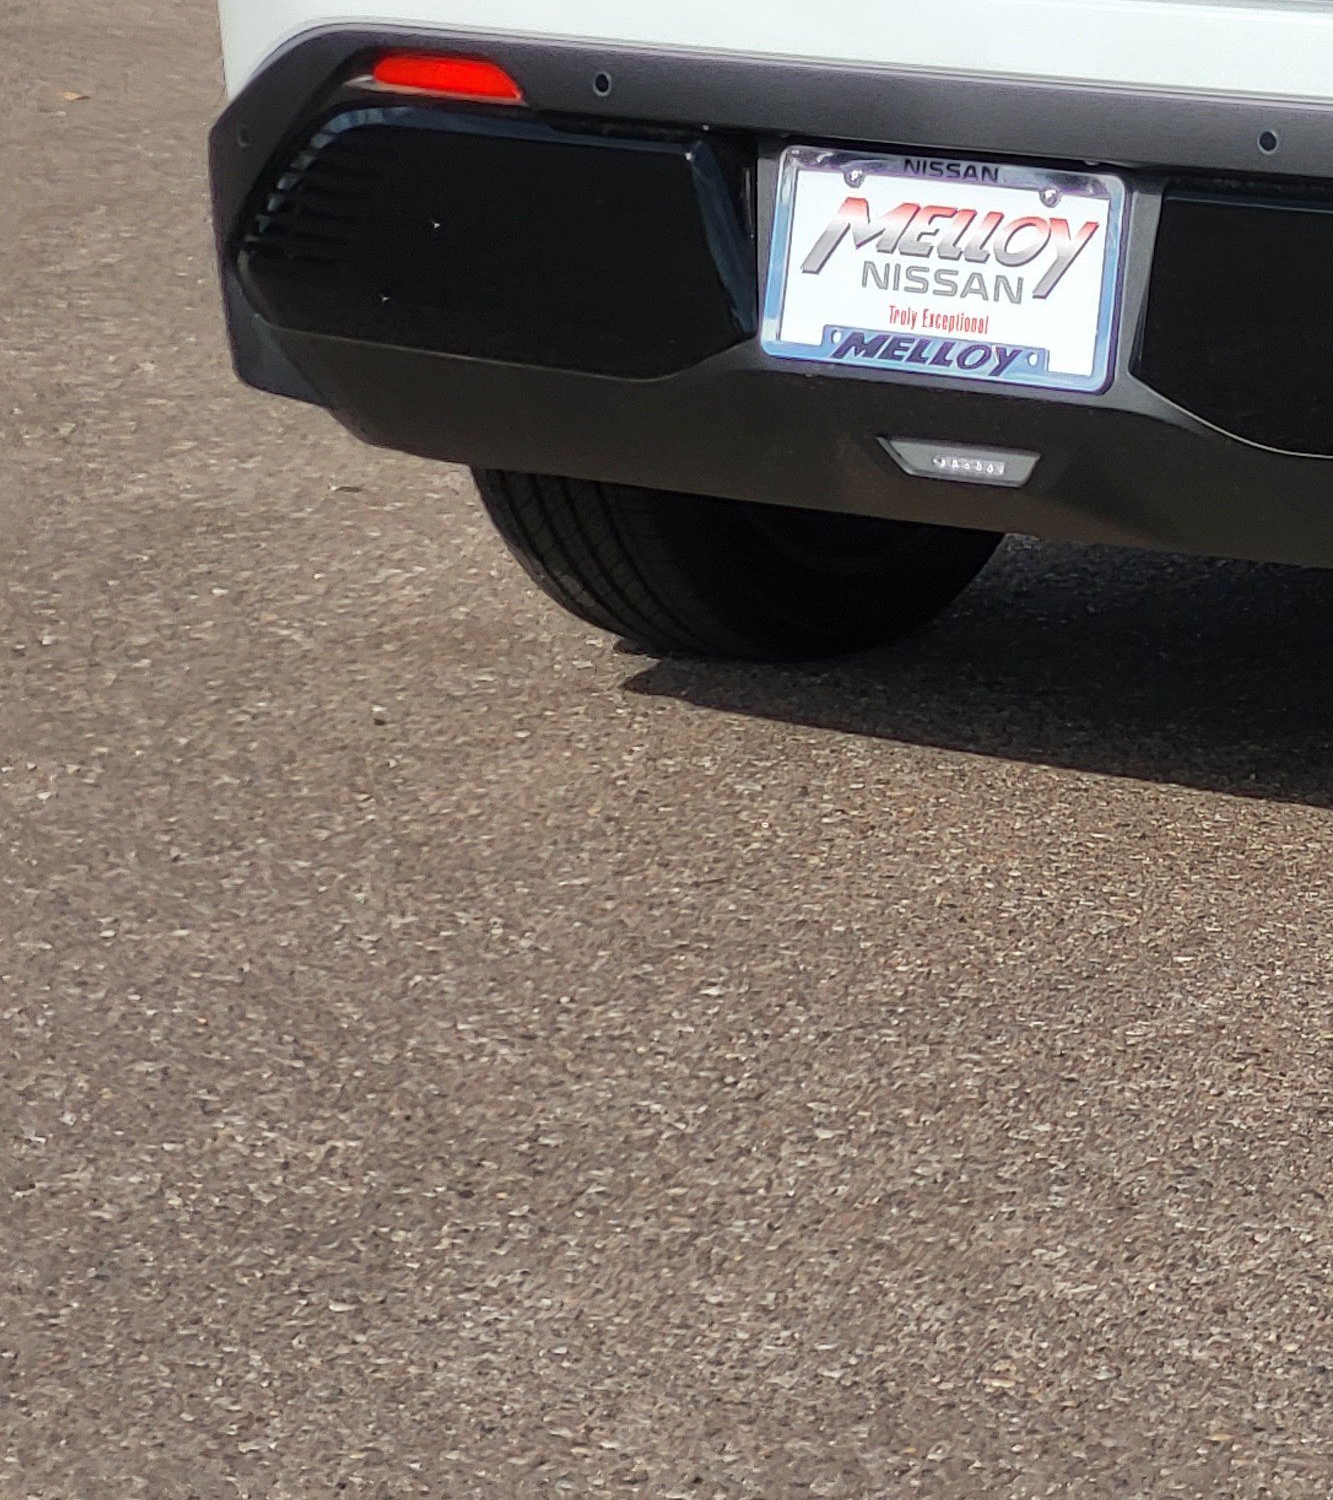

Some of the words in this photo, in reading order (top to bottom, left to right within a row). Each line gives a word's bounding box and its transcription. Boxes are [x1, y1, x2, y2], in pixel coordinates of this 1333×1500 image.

[904, 158, 999, 183] NISSAN
[800, 196, 1099, 300] MELLOY
[861, 260, 1024, 304] NISSAN
[889, 305, 918, 330] Truly
[922, 308, 989, 335] Exceptional
[830, 332, 1022, 376] MELLOY
